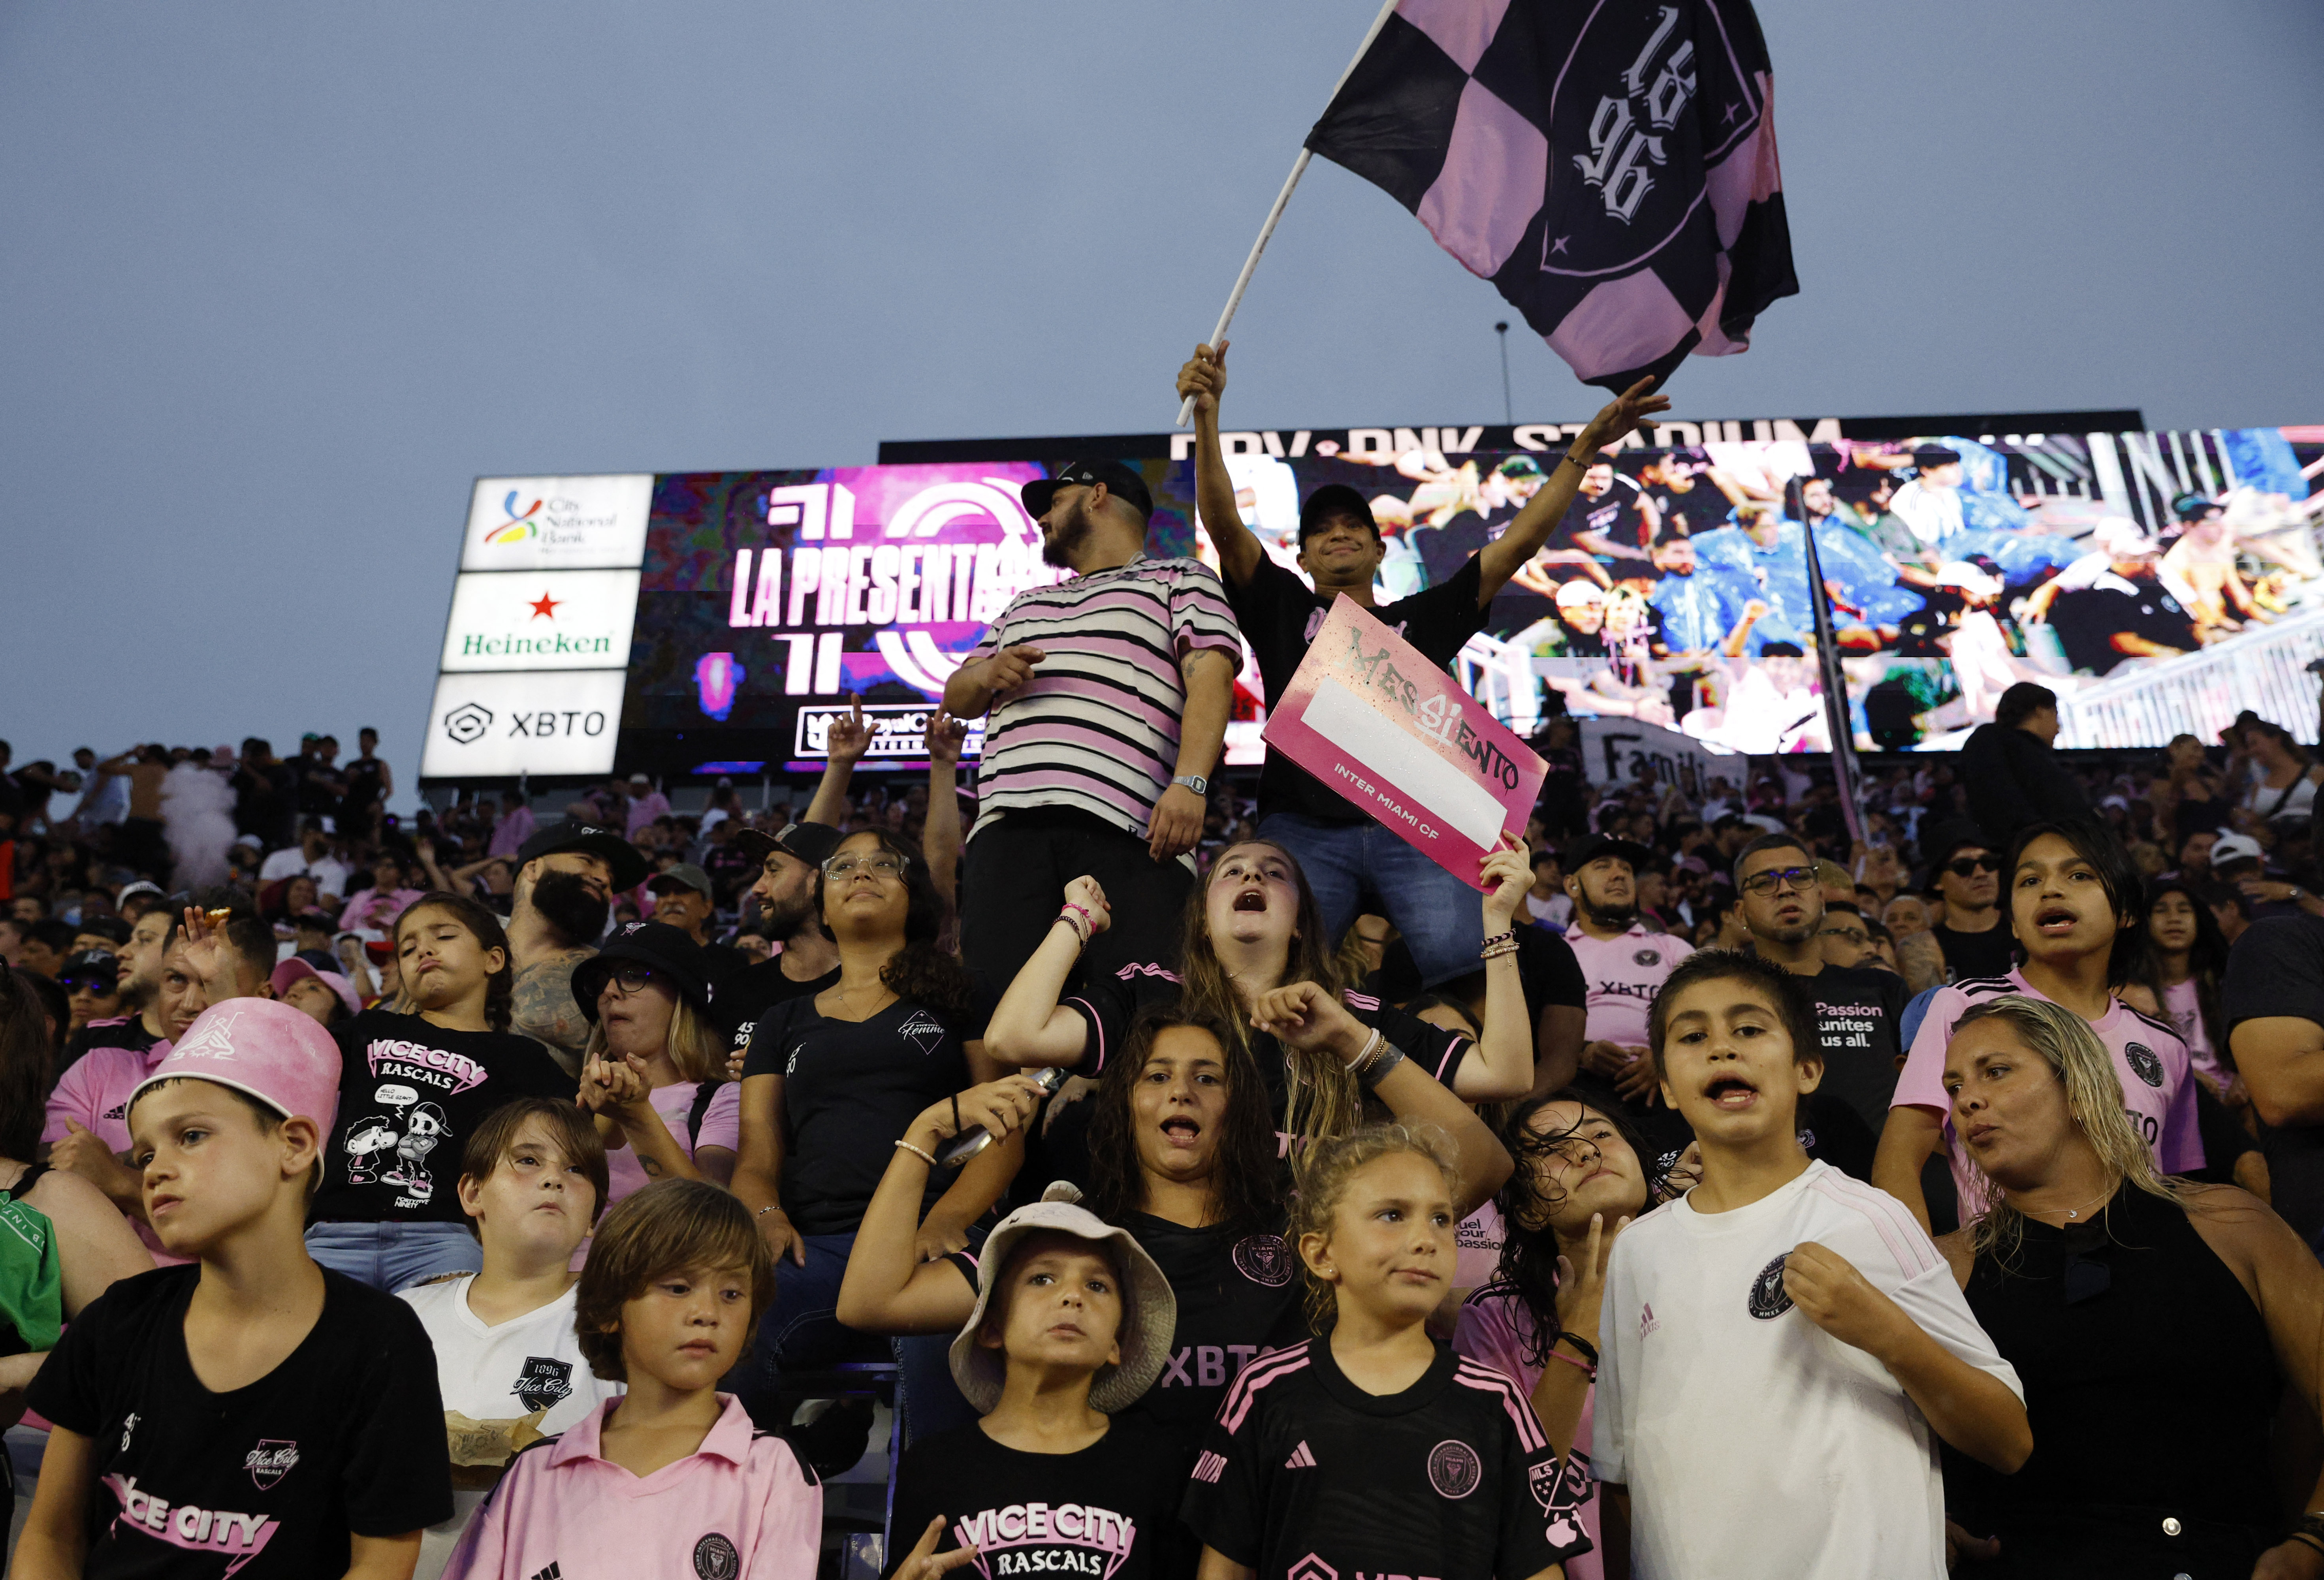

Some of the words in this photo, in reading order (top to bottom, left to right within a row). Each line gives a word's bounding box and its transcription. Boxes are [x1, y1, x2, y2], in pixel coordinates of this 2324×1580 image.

[548, 497, 580, 514] City
[546, 513, 618, 528] National
[541, 530, 585, 544] Bank
[729, 548, 783, 628] LA
[462, 632, 611, 656] Heineken
[509, 712, 605, 737] XBTO
[1334, 763, 1376, 797] INTER
[1377, 793, 1419, 827] MIAMI
[1419, 824, 1439, 839] CF
[1815, 1002, 1883, 1017] Passion
[898, 1021, 945, 1040] Femme
[1818, 1017, 1874, 1032] unites
[734, 1033, 750, 1045] 90
[1821, 1036, 1842, 1047] us
[1845, 1033, 1871, 1048] all.
[372, 1039, 428, 1062] VICE
[427, 1049, 486, 1082] CITY
[380, 1062, 454, 1089] RASCALS
[1460, 1219, 1481, 1229] uel
[1460, 1230, 1486, 1238] our
[1455, 1238, 1502, 1251] passio
[1759, 1308, 1780, 1317] MMXX
[534, 1364, 560, 1377] 1896
[1162, 1345, 1277, 1388] XBT
[513, 1377, 542, 1394] Vice
[543, 1378, 573, 1399] City
[246, 1450, 273, 1466] Vice
[273, 1448, 299, 1469] City
[1531, 1465, 1553, 1481] MLS
[109, 1473, 170, 1530] VCE
[175, 1505, 270, 1545] CITY
[960, 1503, 1048, 1546] VICE
[1054, 1503, 1133, 1547] CITY
[709, 1546, 726, 1556] MIAMI
[997, 1550, 1102, 1576] RASCALS
